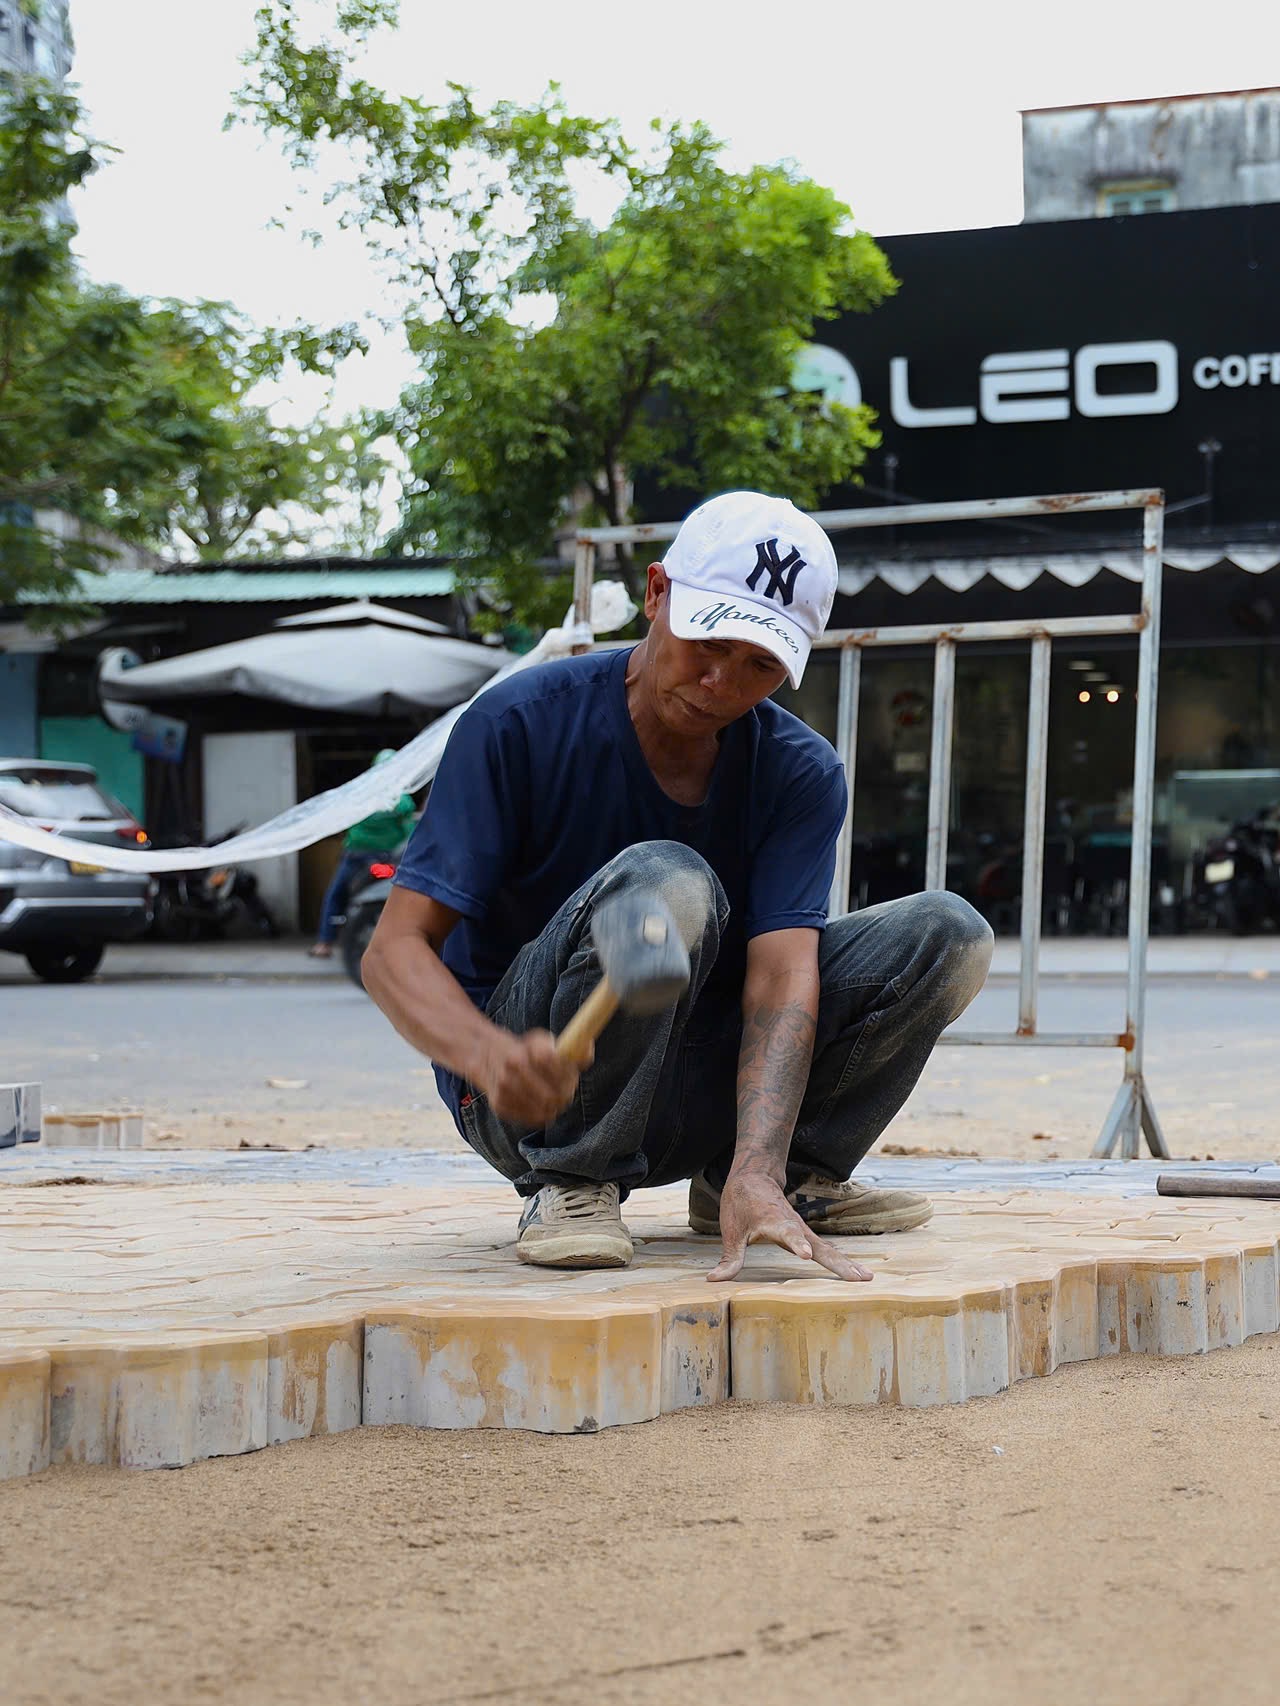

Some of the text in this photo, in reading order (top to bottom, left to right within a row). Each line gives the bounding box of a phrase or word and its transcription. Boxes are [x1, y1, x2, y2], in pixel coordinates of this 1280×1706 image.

[890, 340, 1179, 428] LEO
[745, 538, 807, 606] NY
[690, 602, 800, 654] Yankees
